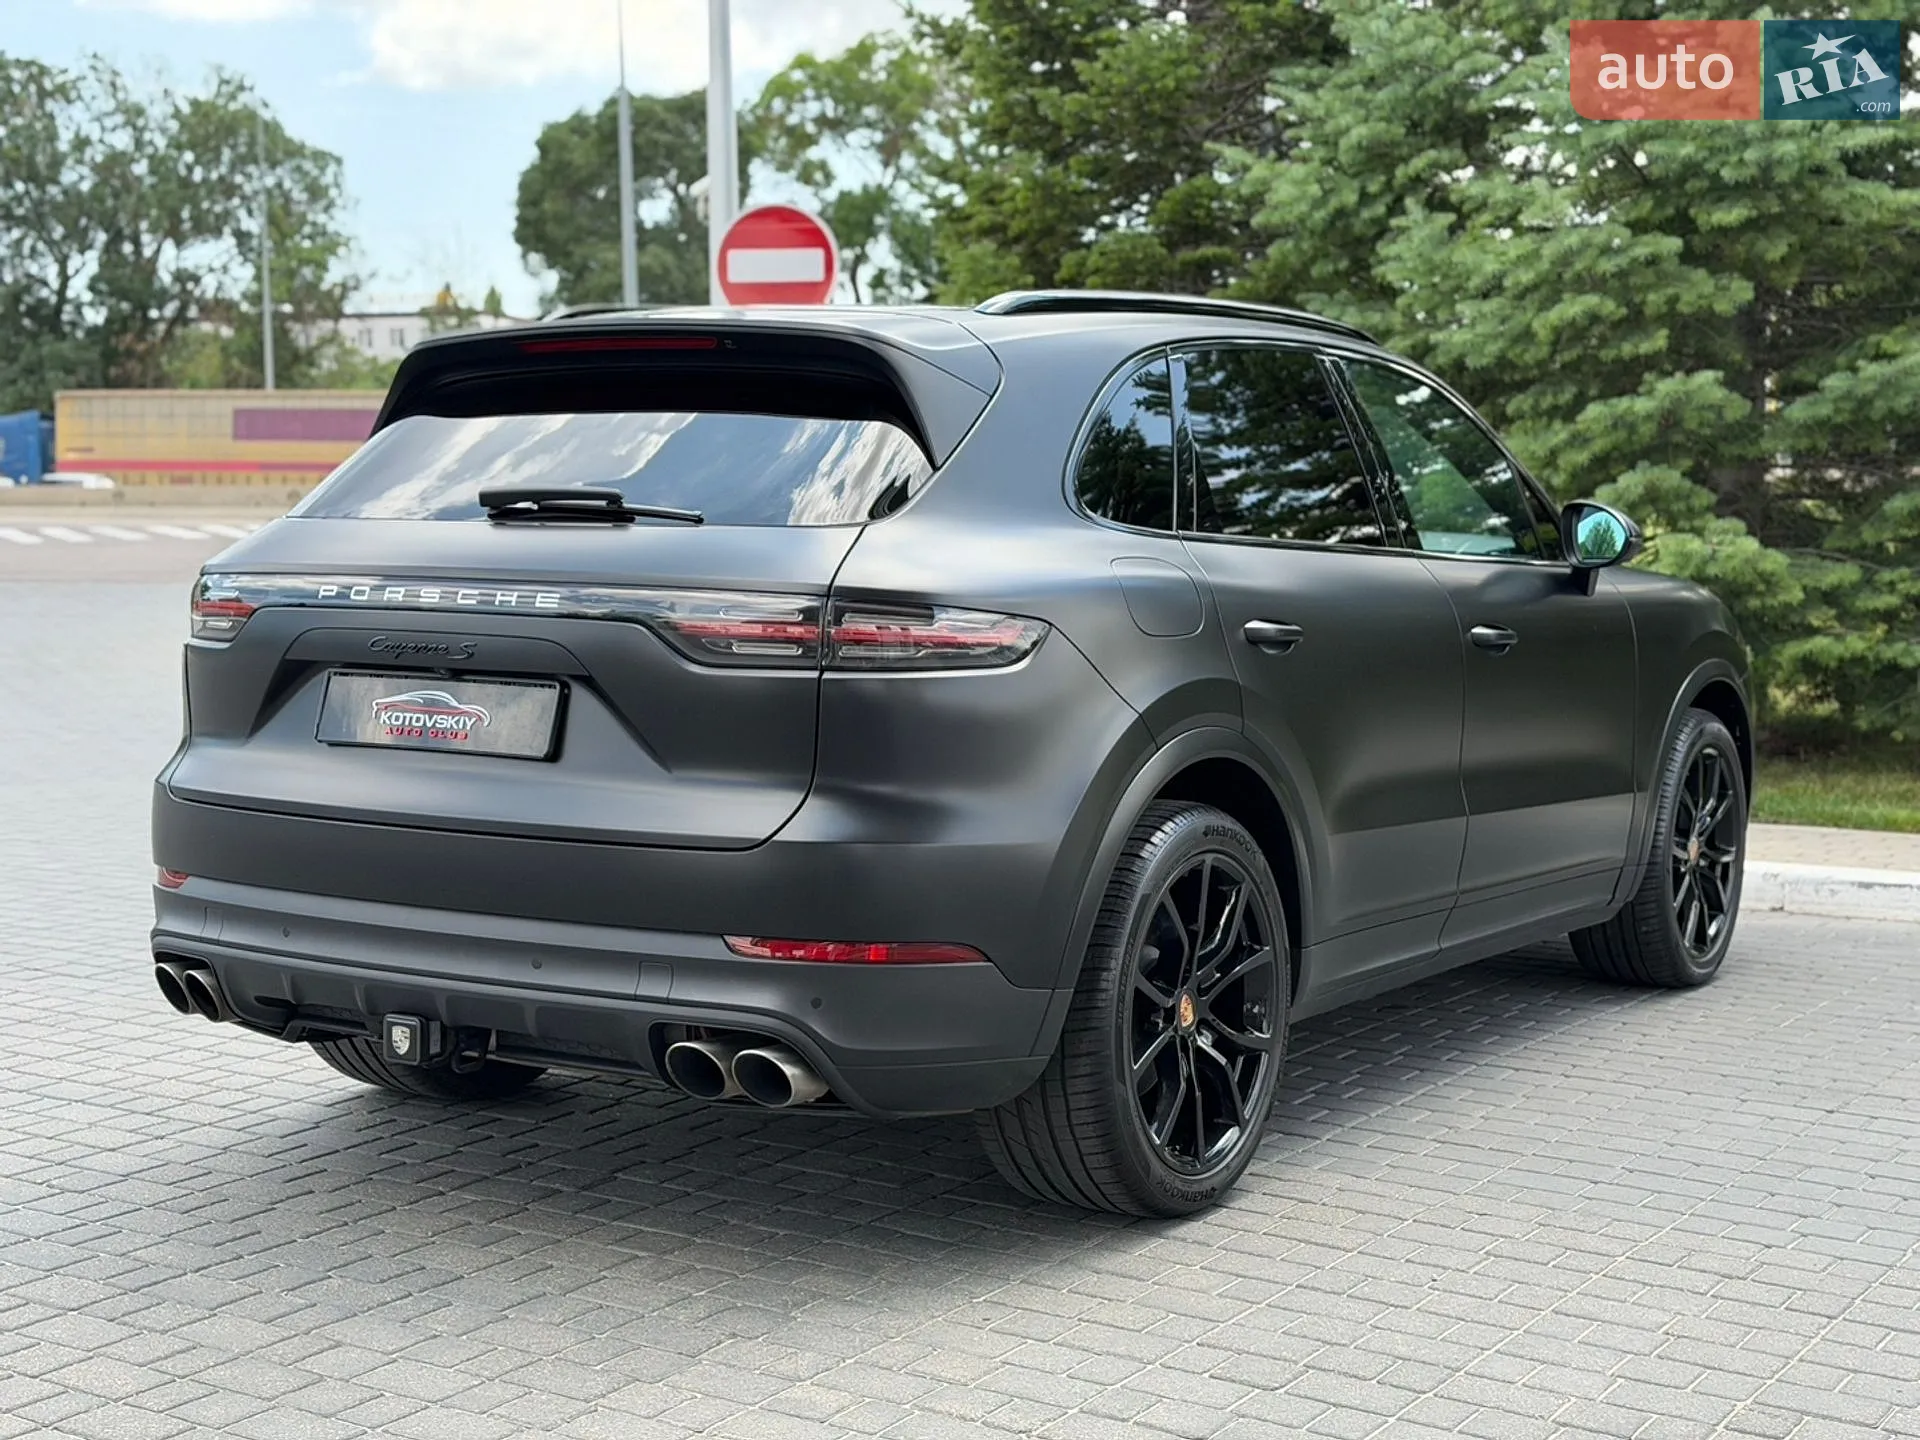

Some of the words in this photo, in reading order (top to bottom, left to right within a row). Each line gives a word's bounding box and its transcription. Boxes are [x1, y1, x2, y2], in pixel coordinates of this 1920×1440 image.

[318, 585, 561, 608] PORSCHE
[367, 635, 448, 659] Cayenne
[448, 642, 478, 659] S
[380, 711, 477, 730] KOTOVSKIY
[385, 727, 423, 737] AUTO
